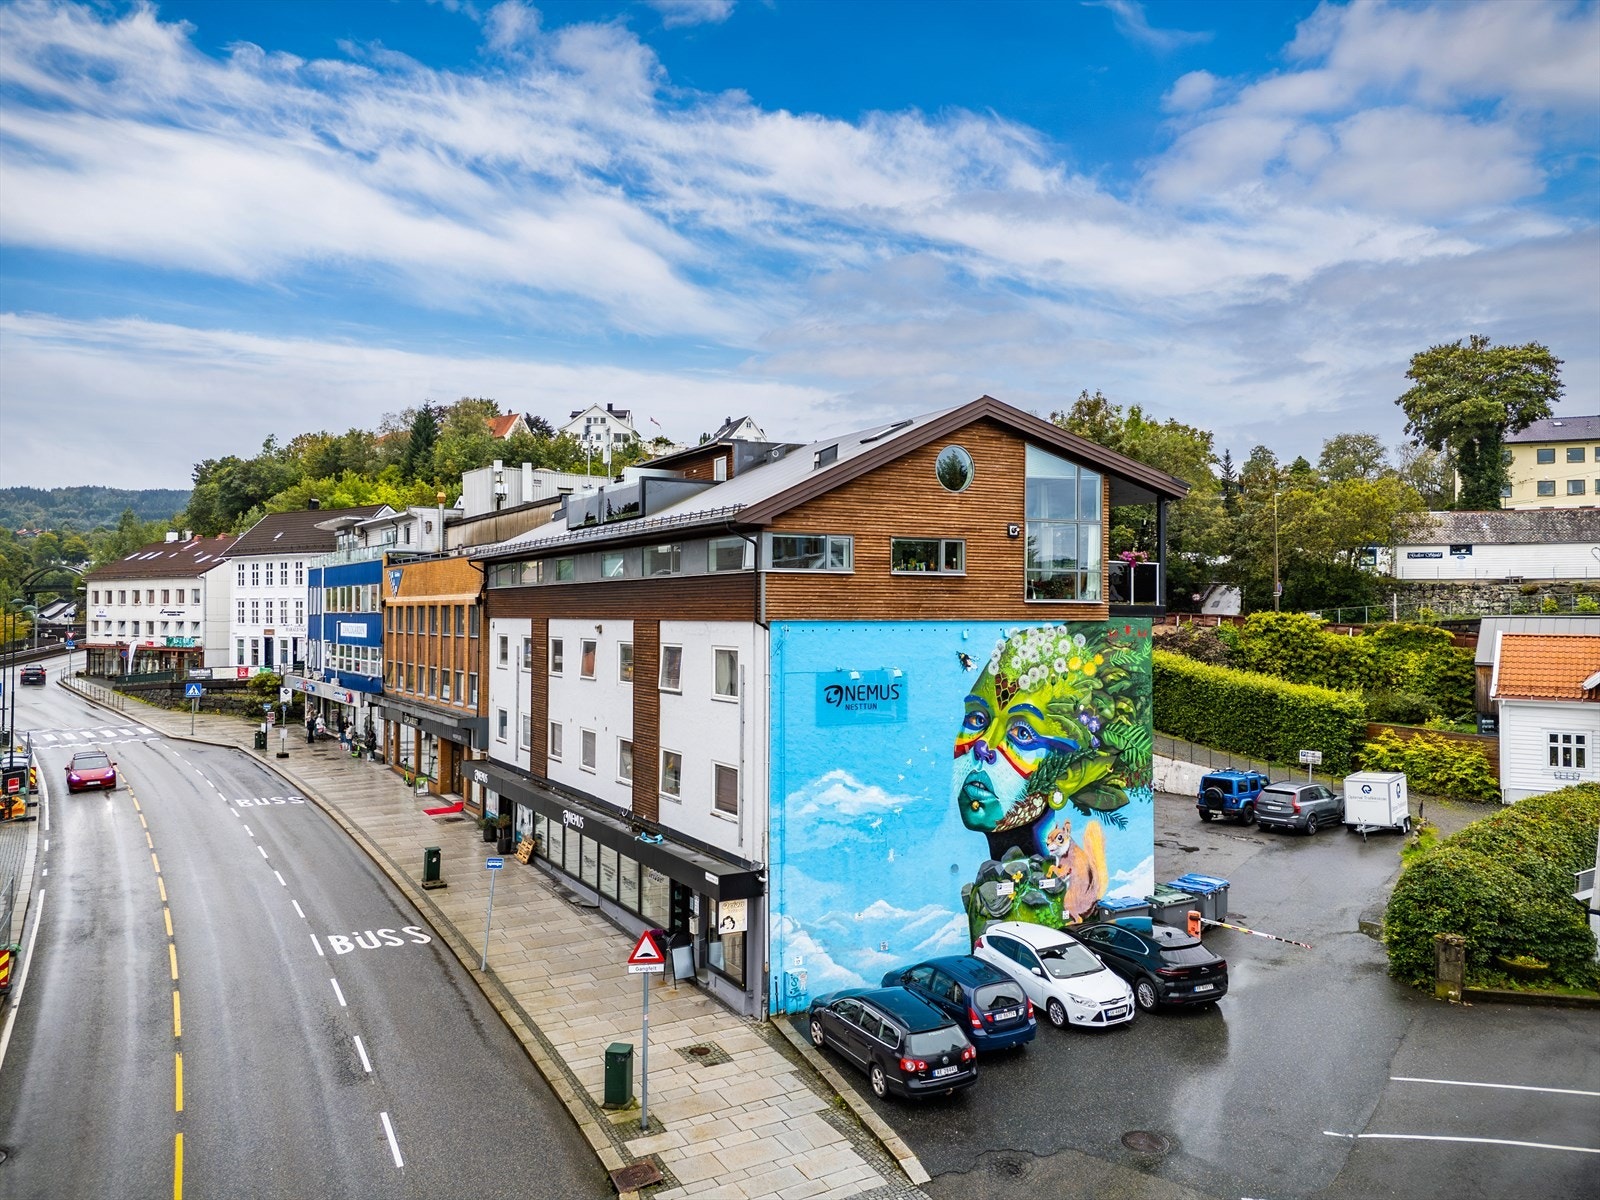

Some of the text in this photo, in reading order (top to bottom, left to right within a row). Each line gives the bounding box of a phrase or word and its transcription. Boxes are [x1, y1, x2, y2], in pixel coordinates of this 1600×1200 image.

[845, 684, 899, 701] NEMUS
[236, 797, 304, 807] BUSS
[567, 811, 584, 828] NEMUS
[328, 926, 432, 955] BUSS
